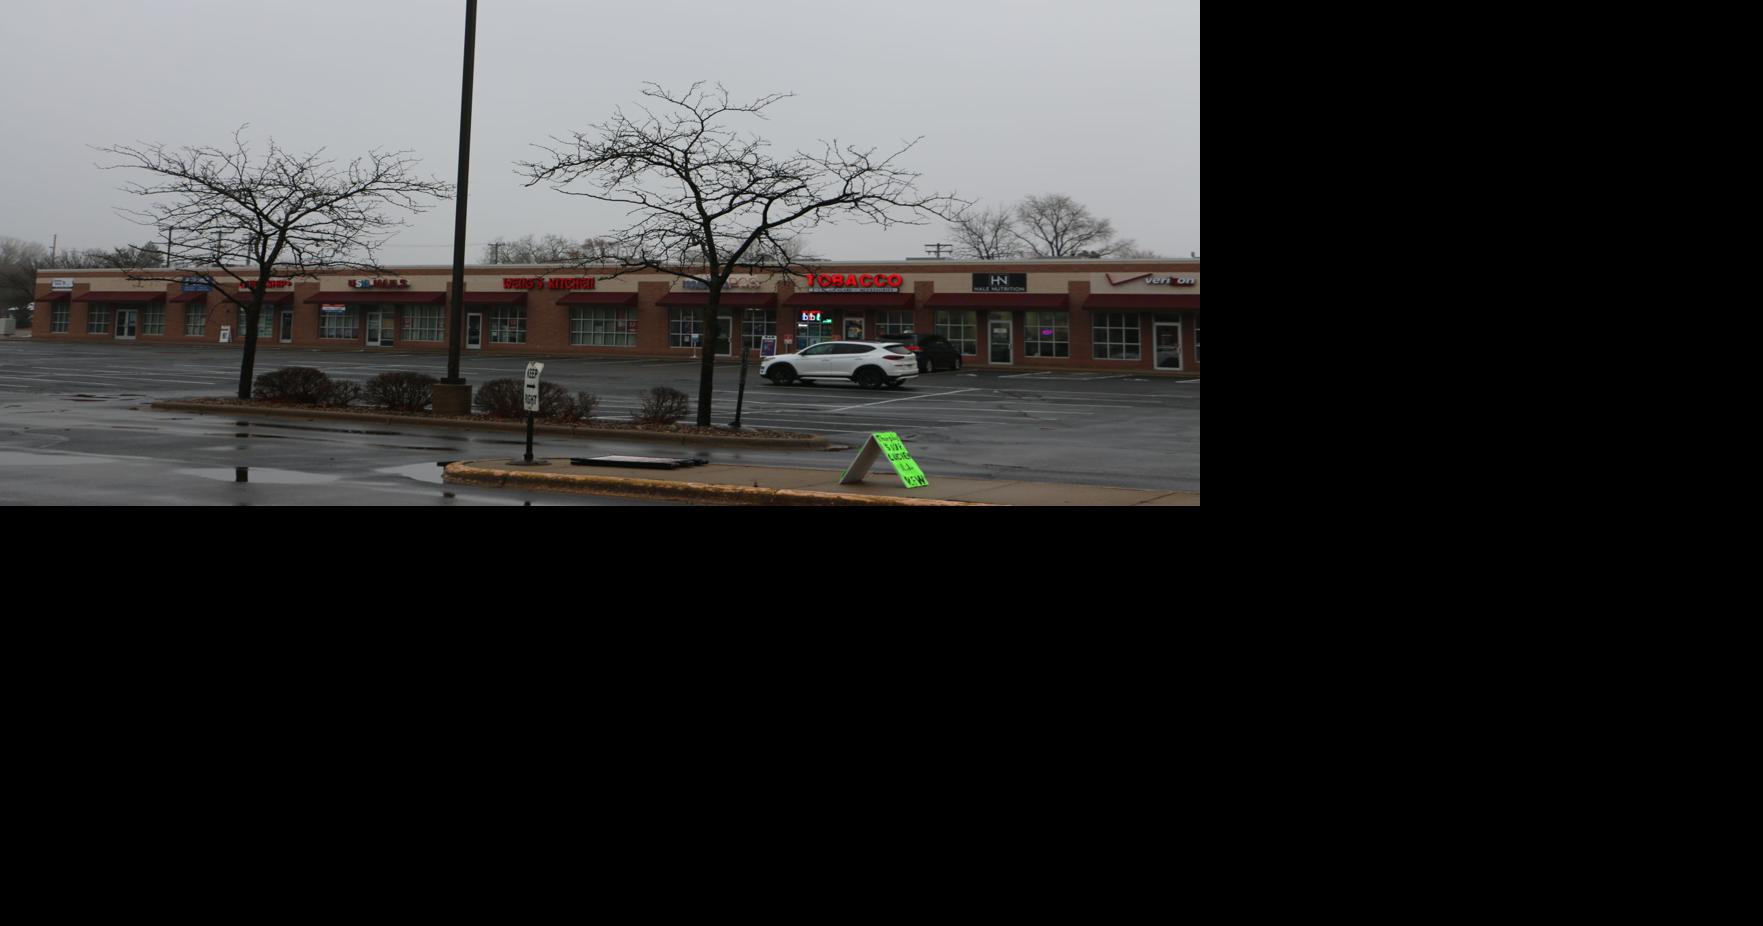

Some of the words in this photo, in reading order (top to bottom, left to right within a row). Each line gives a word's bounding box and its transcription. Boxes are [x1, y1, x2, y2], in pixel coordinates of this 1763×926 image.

[548, 278, 595, 289] KITCHEN
[806, 273, 903, 287] TOBACCO
[990, 275, 1009, 285] HN
[1145, 276, 1196, 286] verizon
